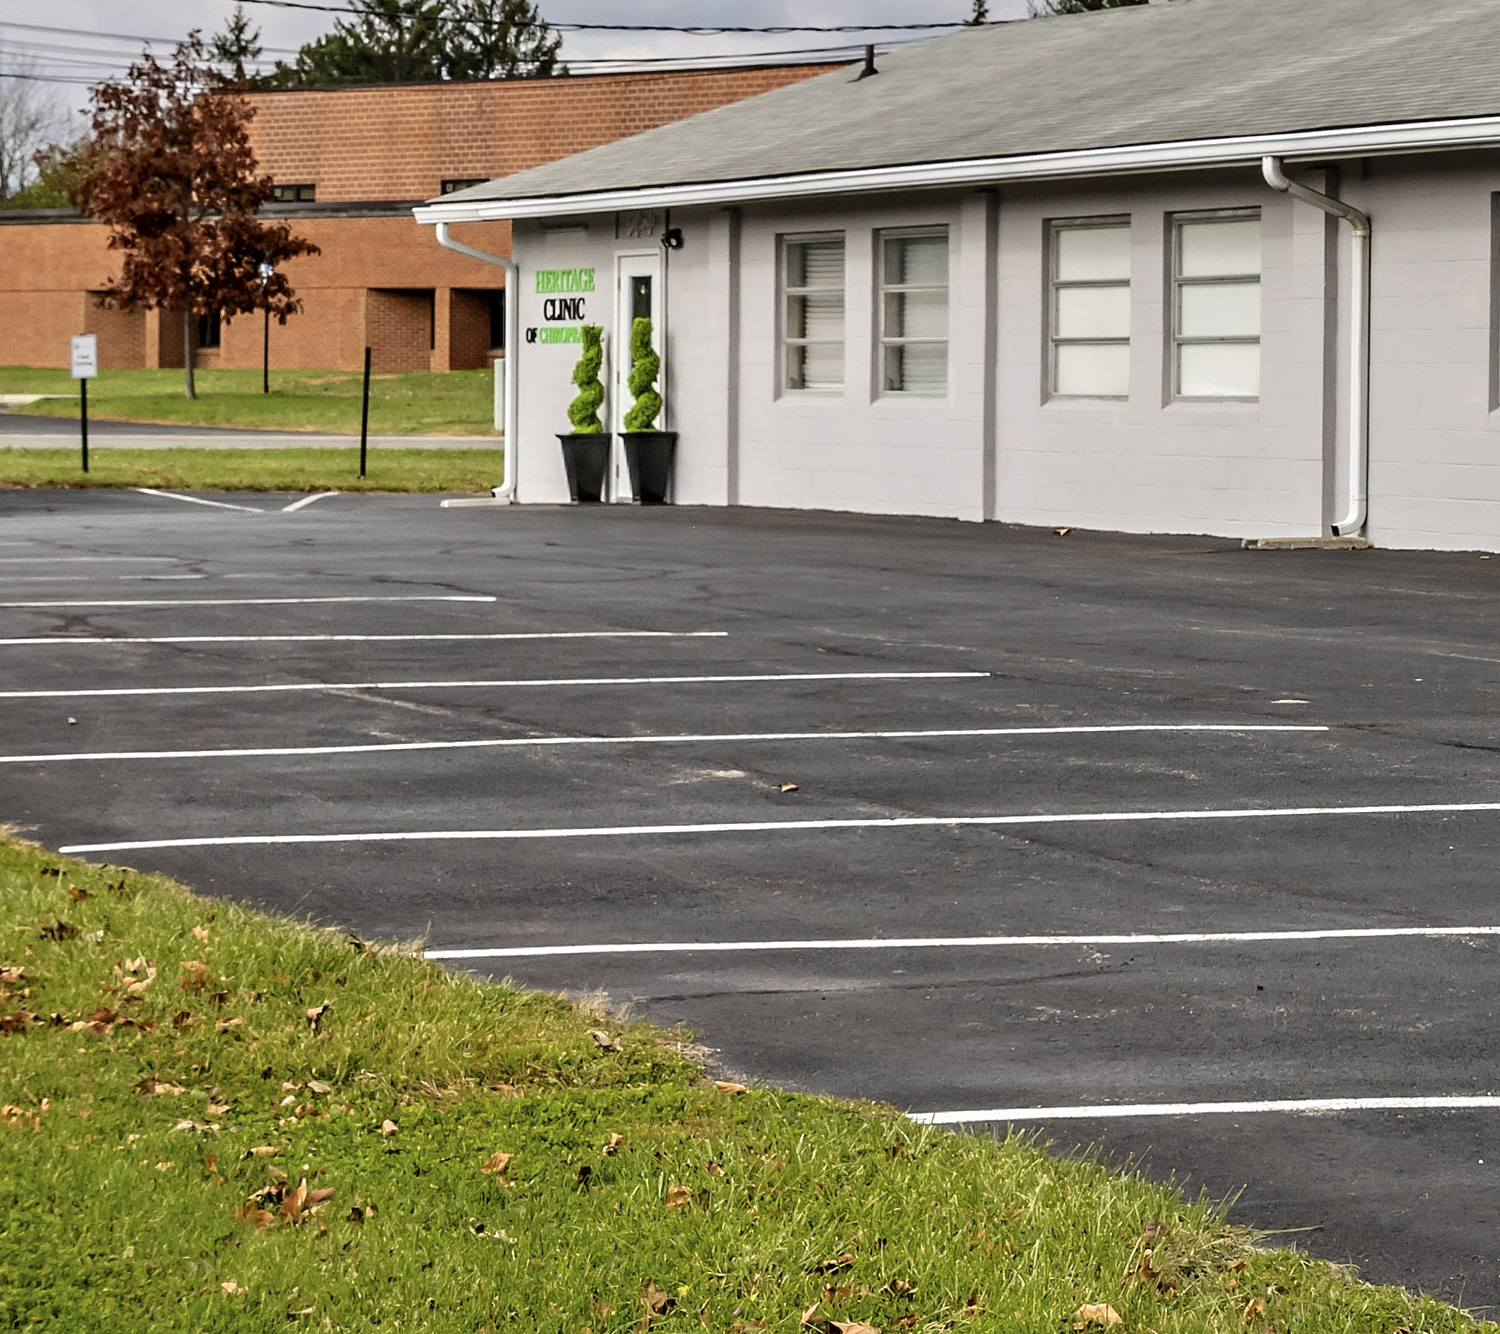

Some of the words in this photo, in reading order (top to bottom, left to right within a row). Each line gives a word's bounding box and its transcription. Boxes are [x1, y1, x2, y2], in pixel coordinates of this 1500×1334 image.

[534, 268, 595, 294] HERITAGE
[543, 297, 586, 321] CLINIC
[526, 327, 538, 344] OF
